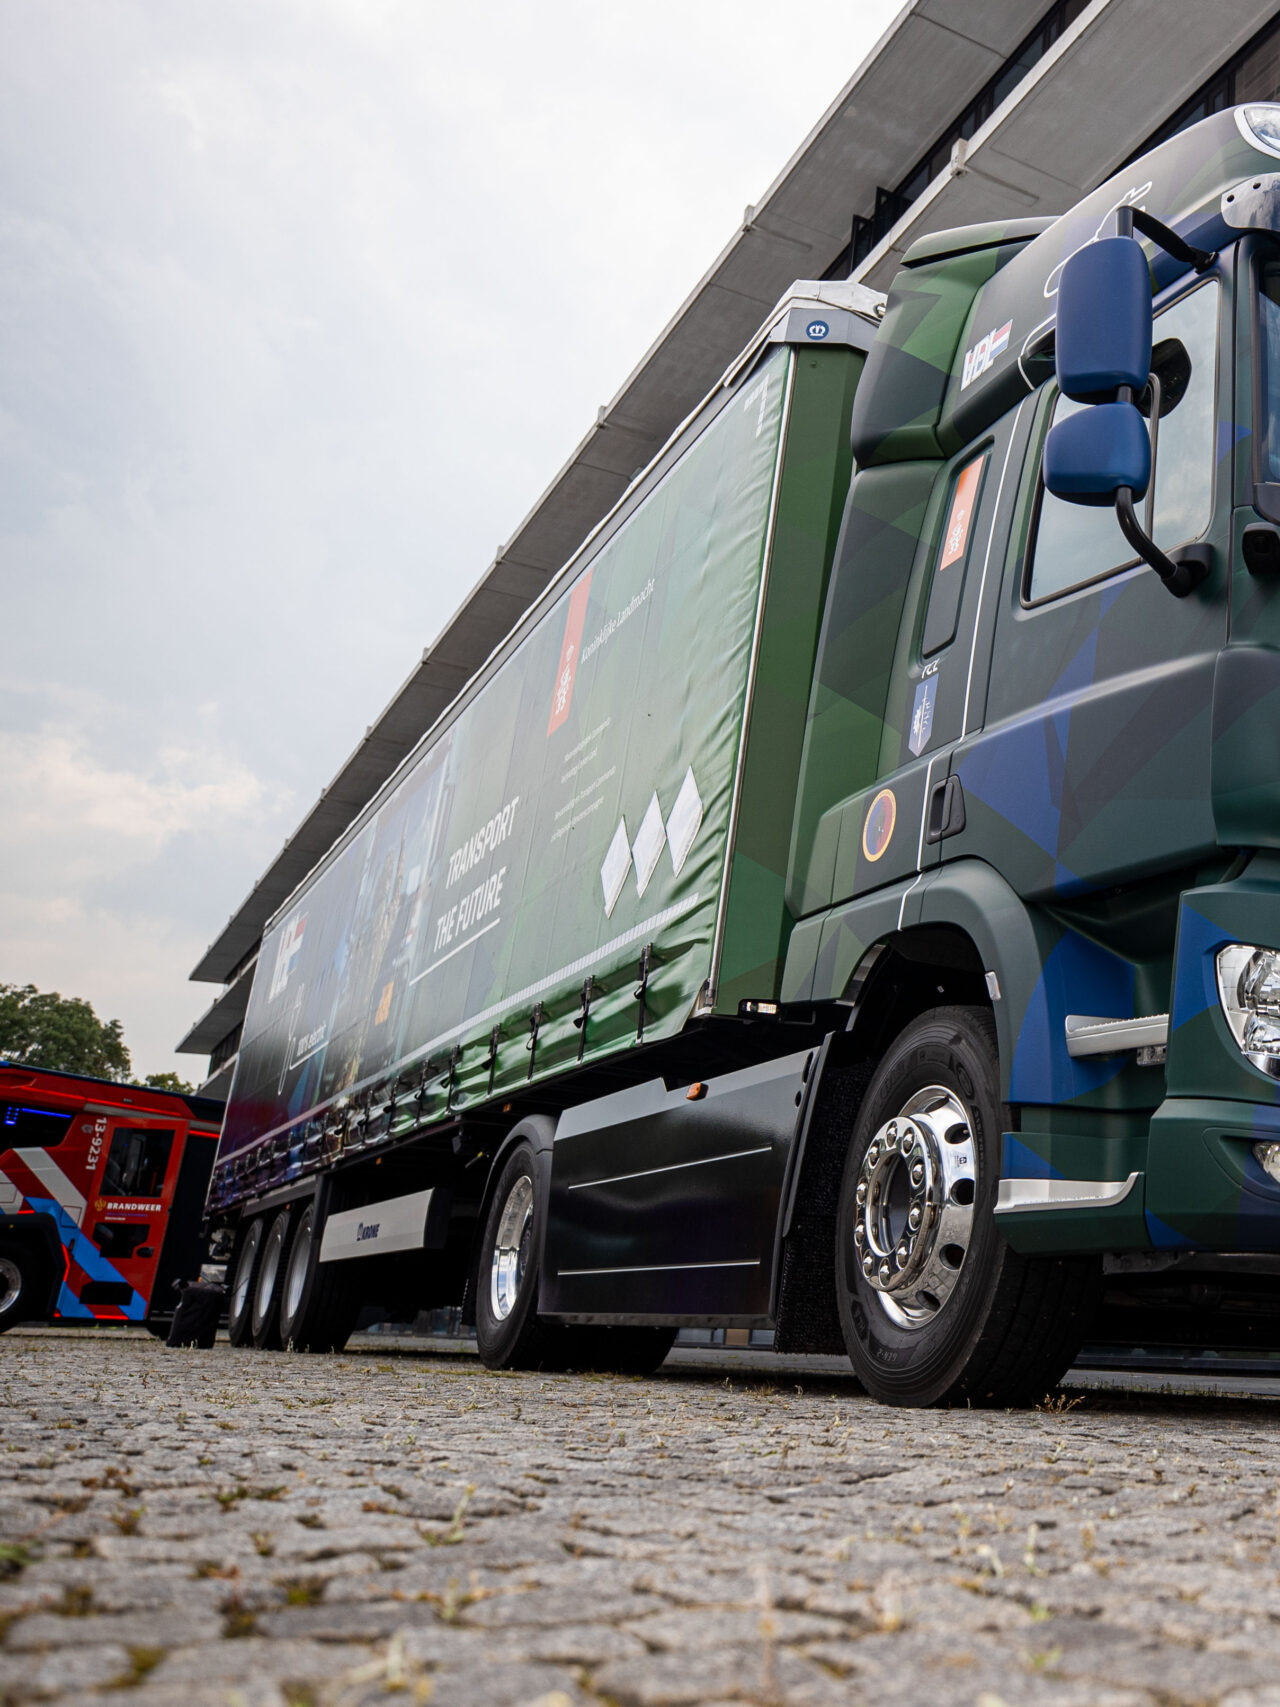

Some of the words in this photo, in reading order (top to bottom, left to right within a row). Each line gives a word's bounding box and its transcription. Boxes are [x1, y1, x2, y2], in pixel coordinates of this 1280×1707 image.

[445, 795, 520, 890] TRANSPORT
[433, 904, 458, 953] THE
[454, 865, 507, 937] FUTURE
[85, 1117, 107, 1170] 13-9231
[106, 1202, 162, 1212] BRANDWEER
